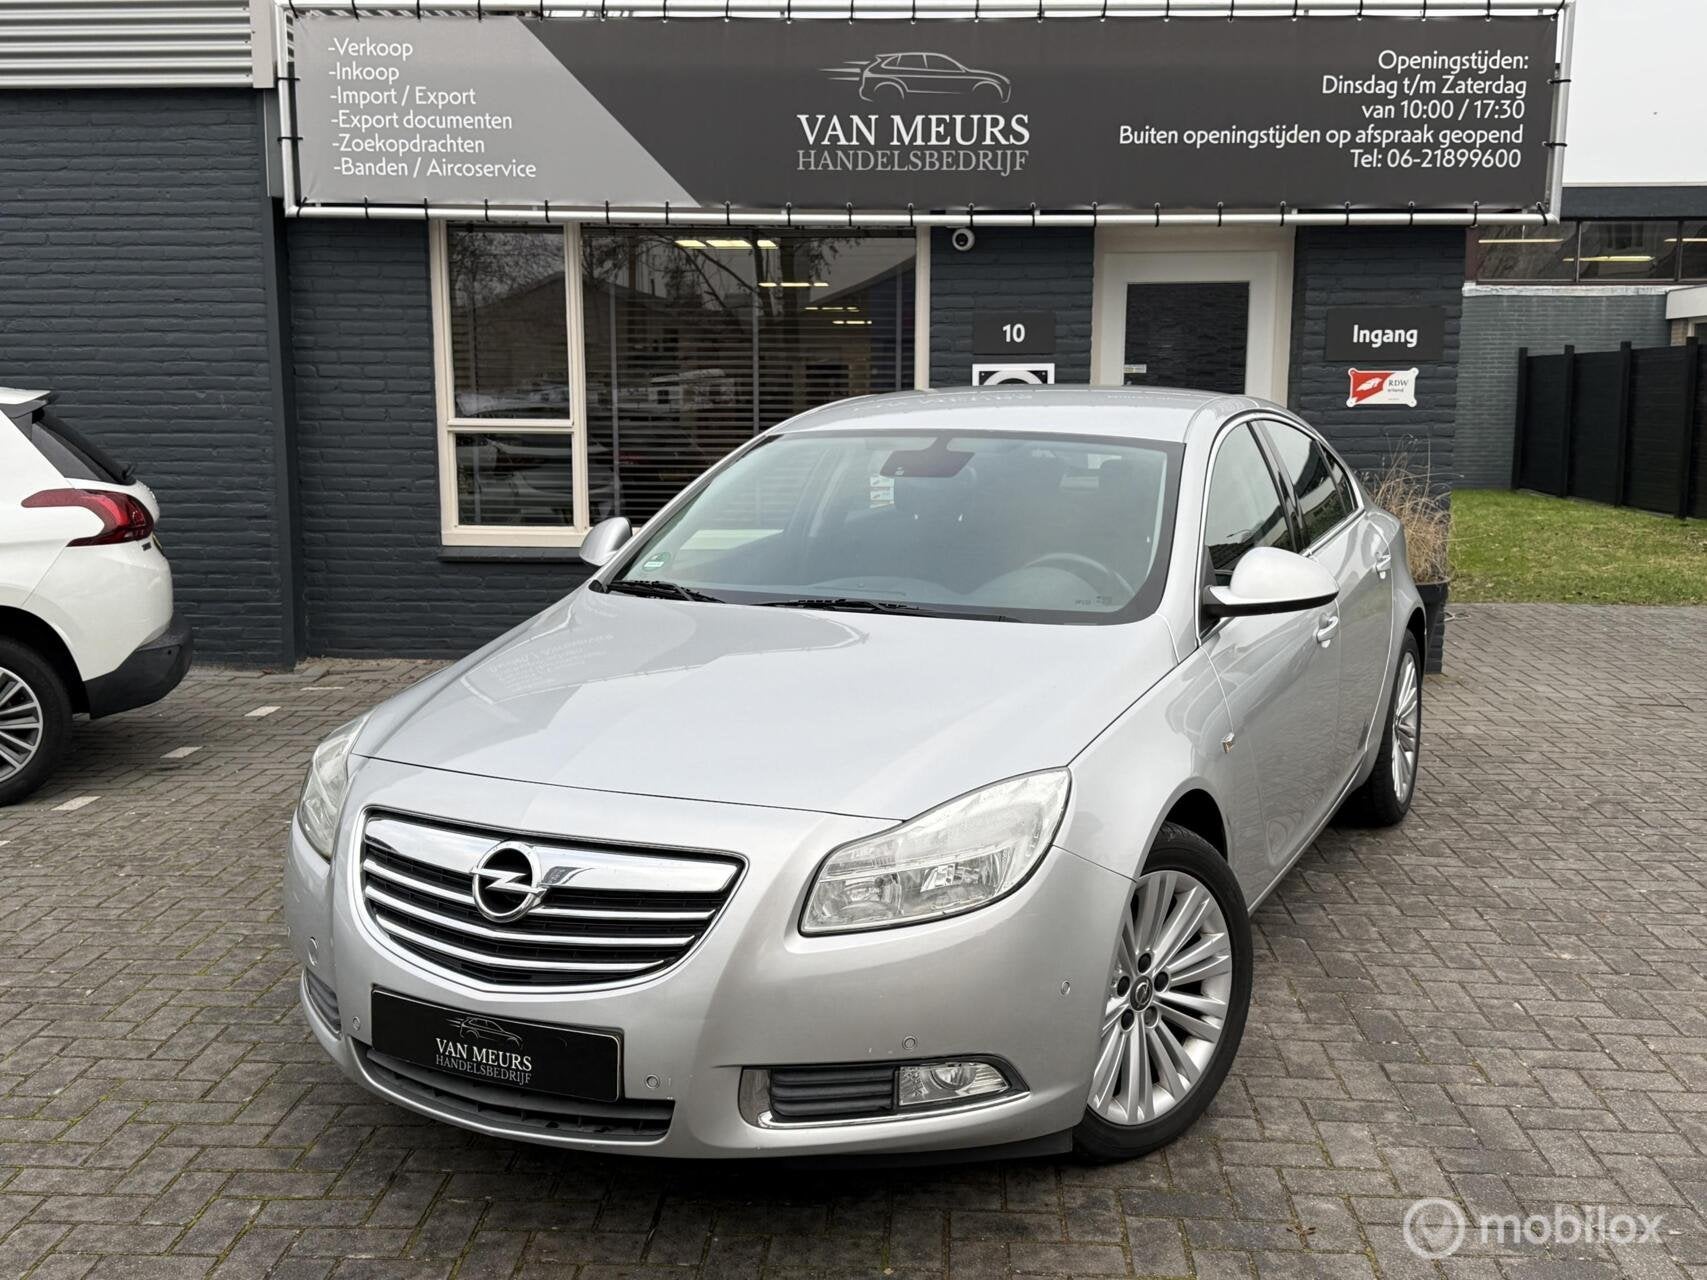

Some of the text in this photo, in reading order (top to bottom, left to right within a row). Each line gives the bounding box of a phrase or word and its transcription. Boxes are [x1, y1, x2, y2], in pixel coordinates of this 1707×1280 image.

[328, 37, 413, 61] -Verkoop
[328, 61, 400, 84] -Inkoop
[1378, 50, 1529, 74] Openingstijden:
[330, 86, 477, 108] -Import / Export
[1322, 74, 1527, 99] Dinsdag t/m Zaterdag
[331, 110, 513, 131] -Export documenten
[1361, 100, 1525, 120] van 10:00 / 17:30
[797, 114, 1030, 146] VAN MEURS
[1119, 124, 1524, 150] Buiten openingstijden op afspraak geopend
[332, 133, 486, 156] -Zoekopdrachten
[334, 157, 537, 178] -Banden / Aircoservice
[797, 150, 1029, 176] HANDELSBEDRIJF
[1350, 149, 1522, 168] Tel: 06-21899600
[1002, 323, 1026, 343] 10
[1352, 325, 1418, 348] Ingang
[1388, 379, 1409, 387] RDW
[436, 1037, 532, 1072] VAN MEURS
[435, 1054, 532, 1085] HANDELSBEDRIJF
